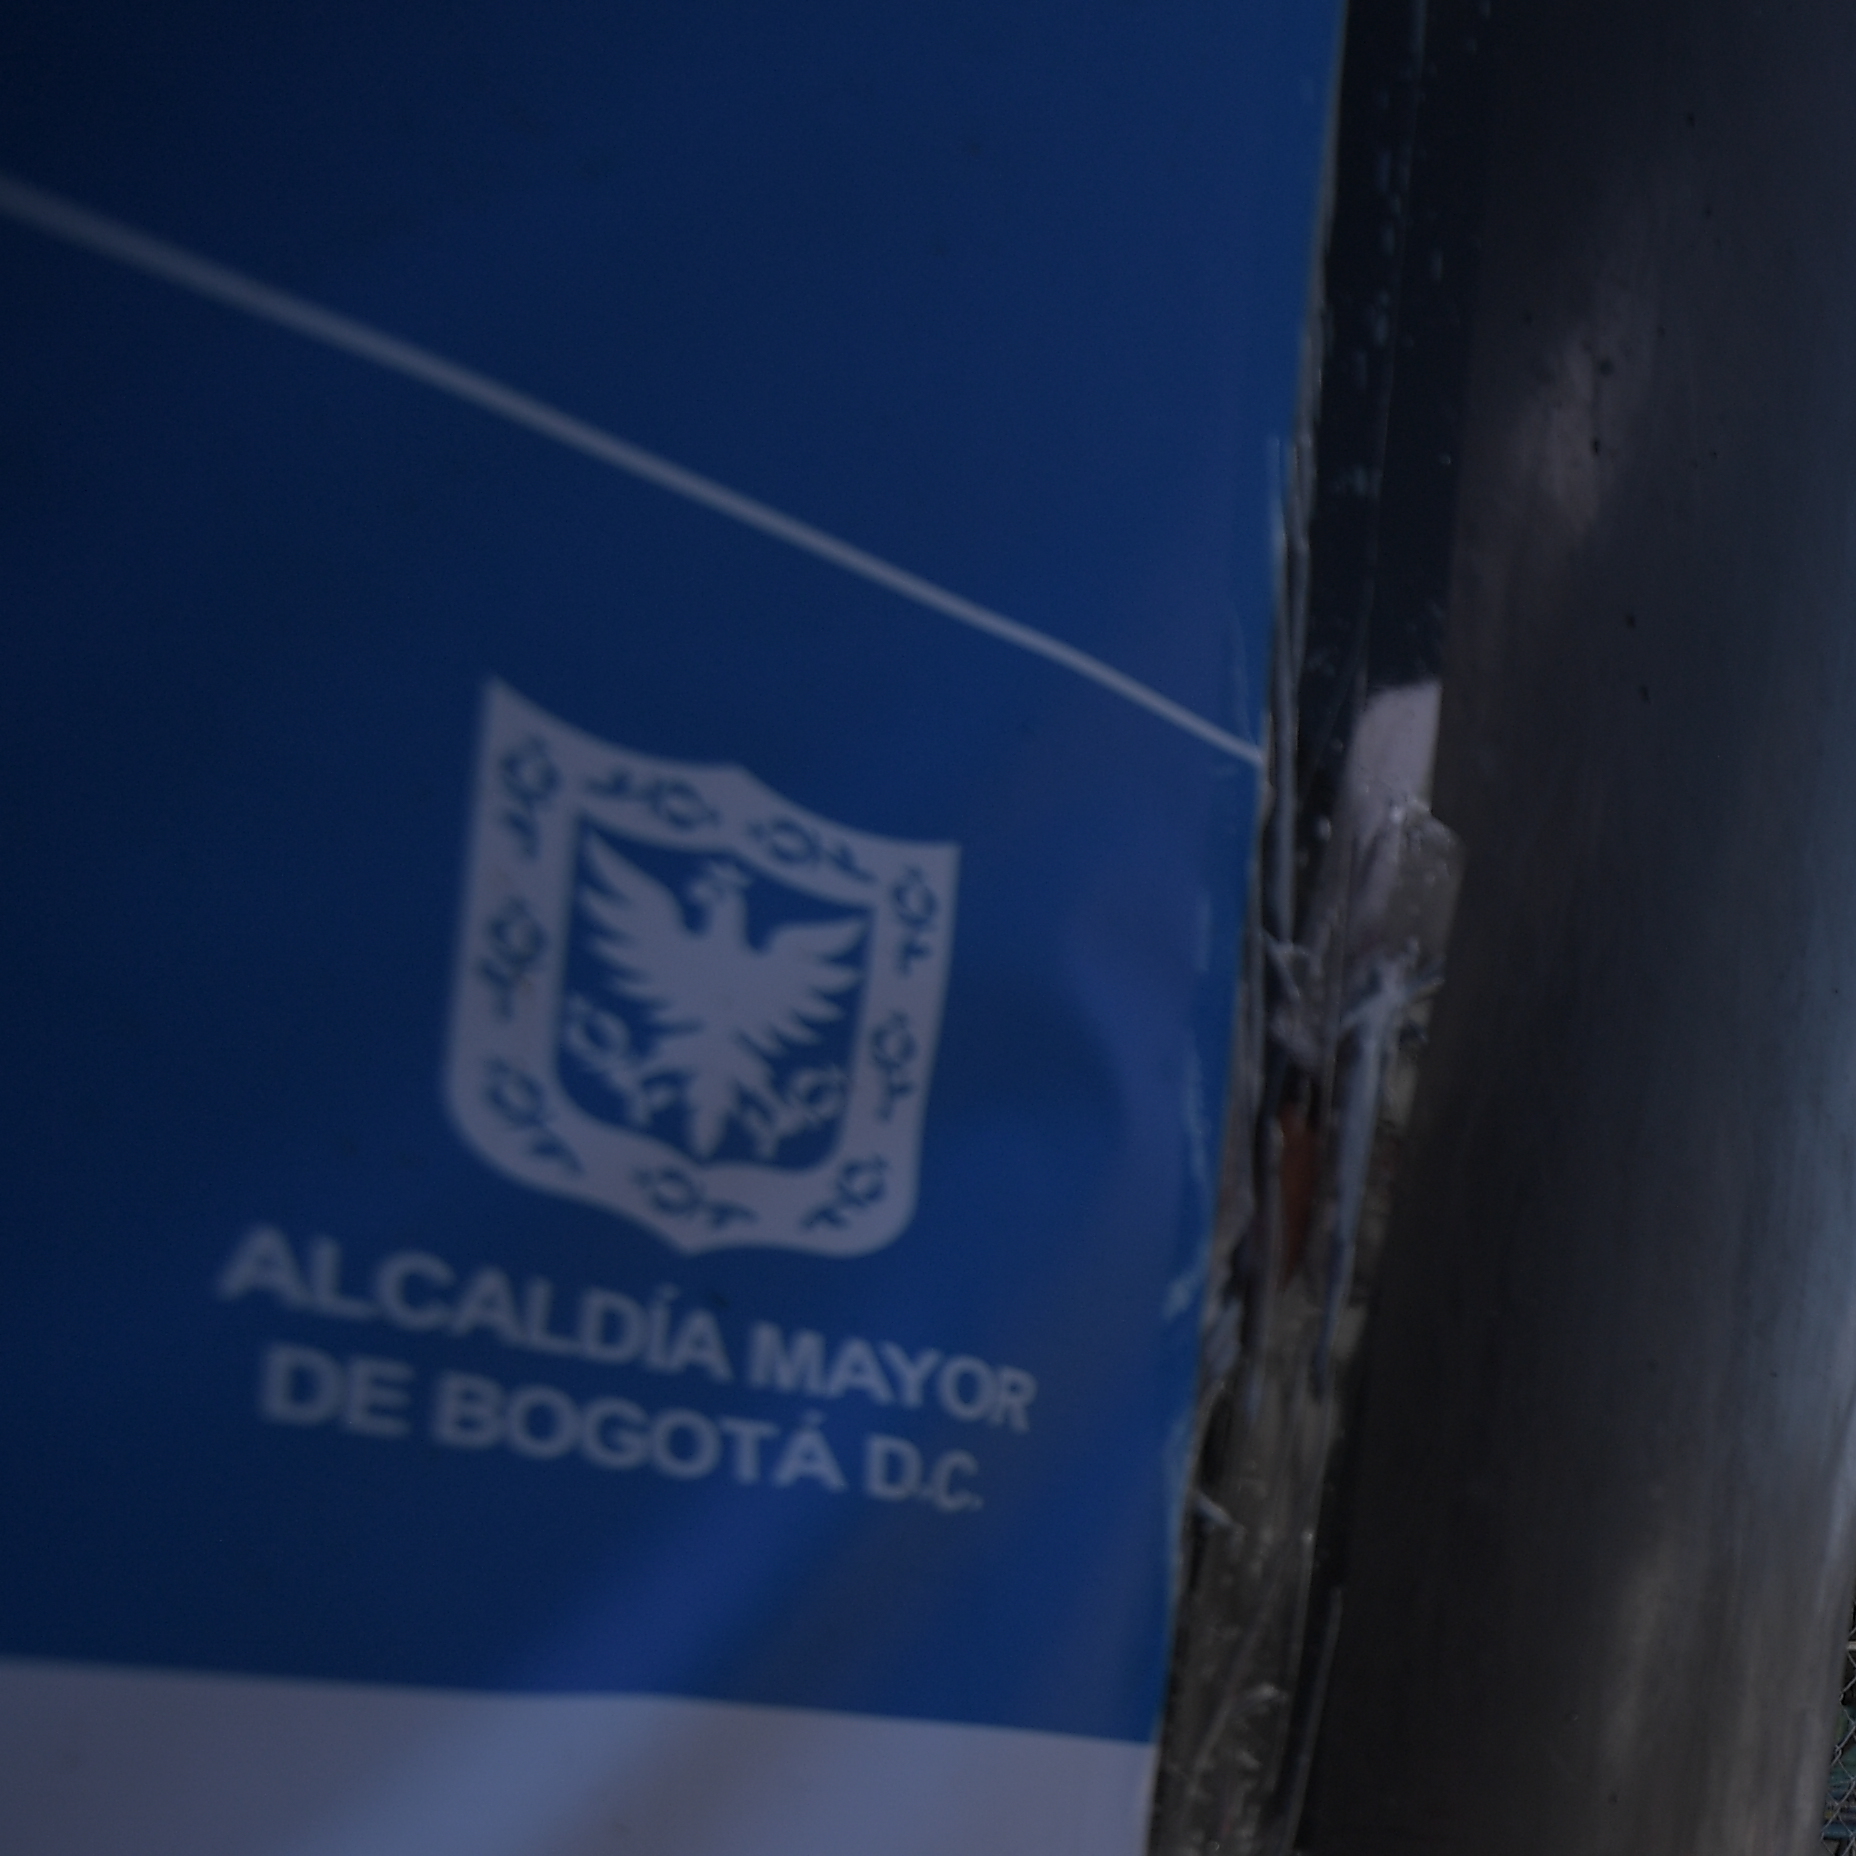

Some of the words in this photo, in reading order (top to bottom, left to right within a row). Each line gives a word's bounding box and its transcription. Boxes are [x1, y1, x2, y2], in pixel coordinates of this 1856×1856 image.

[219, 1223, 736, 1384] ALCALDÍA
[747, 1319, 1040, 1435] MAYOR
[261, 1341, 415, 1438] DE
[432, 1368, 848, 1494] BOGOTÁ
